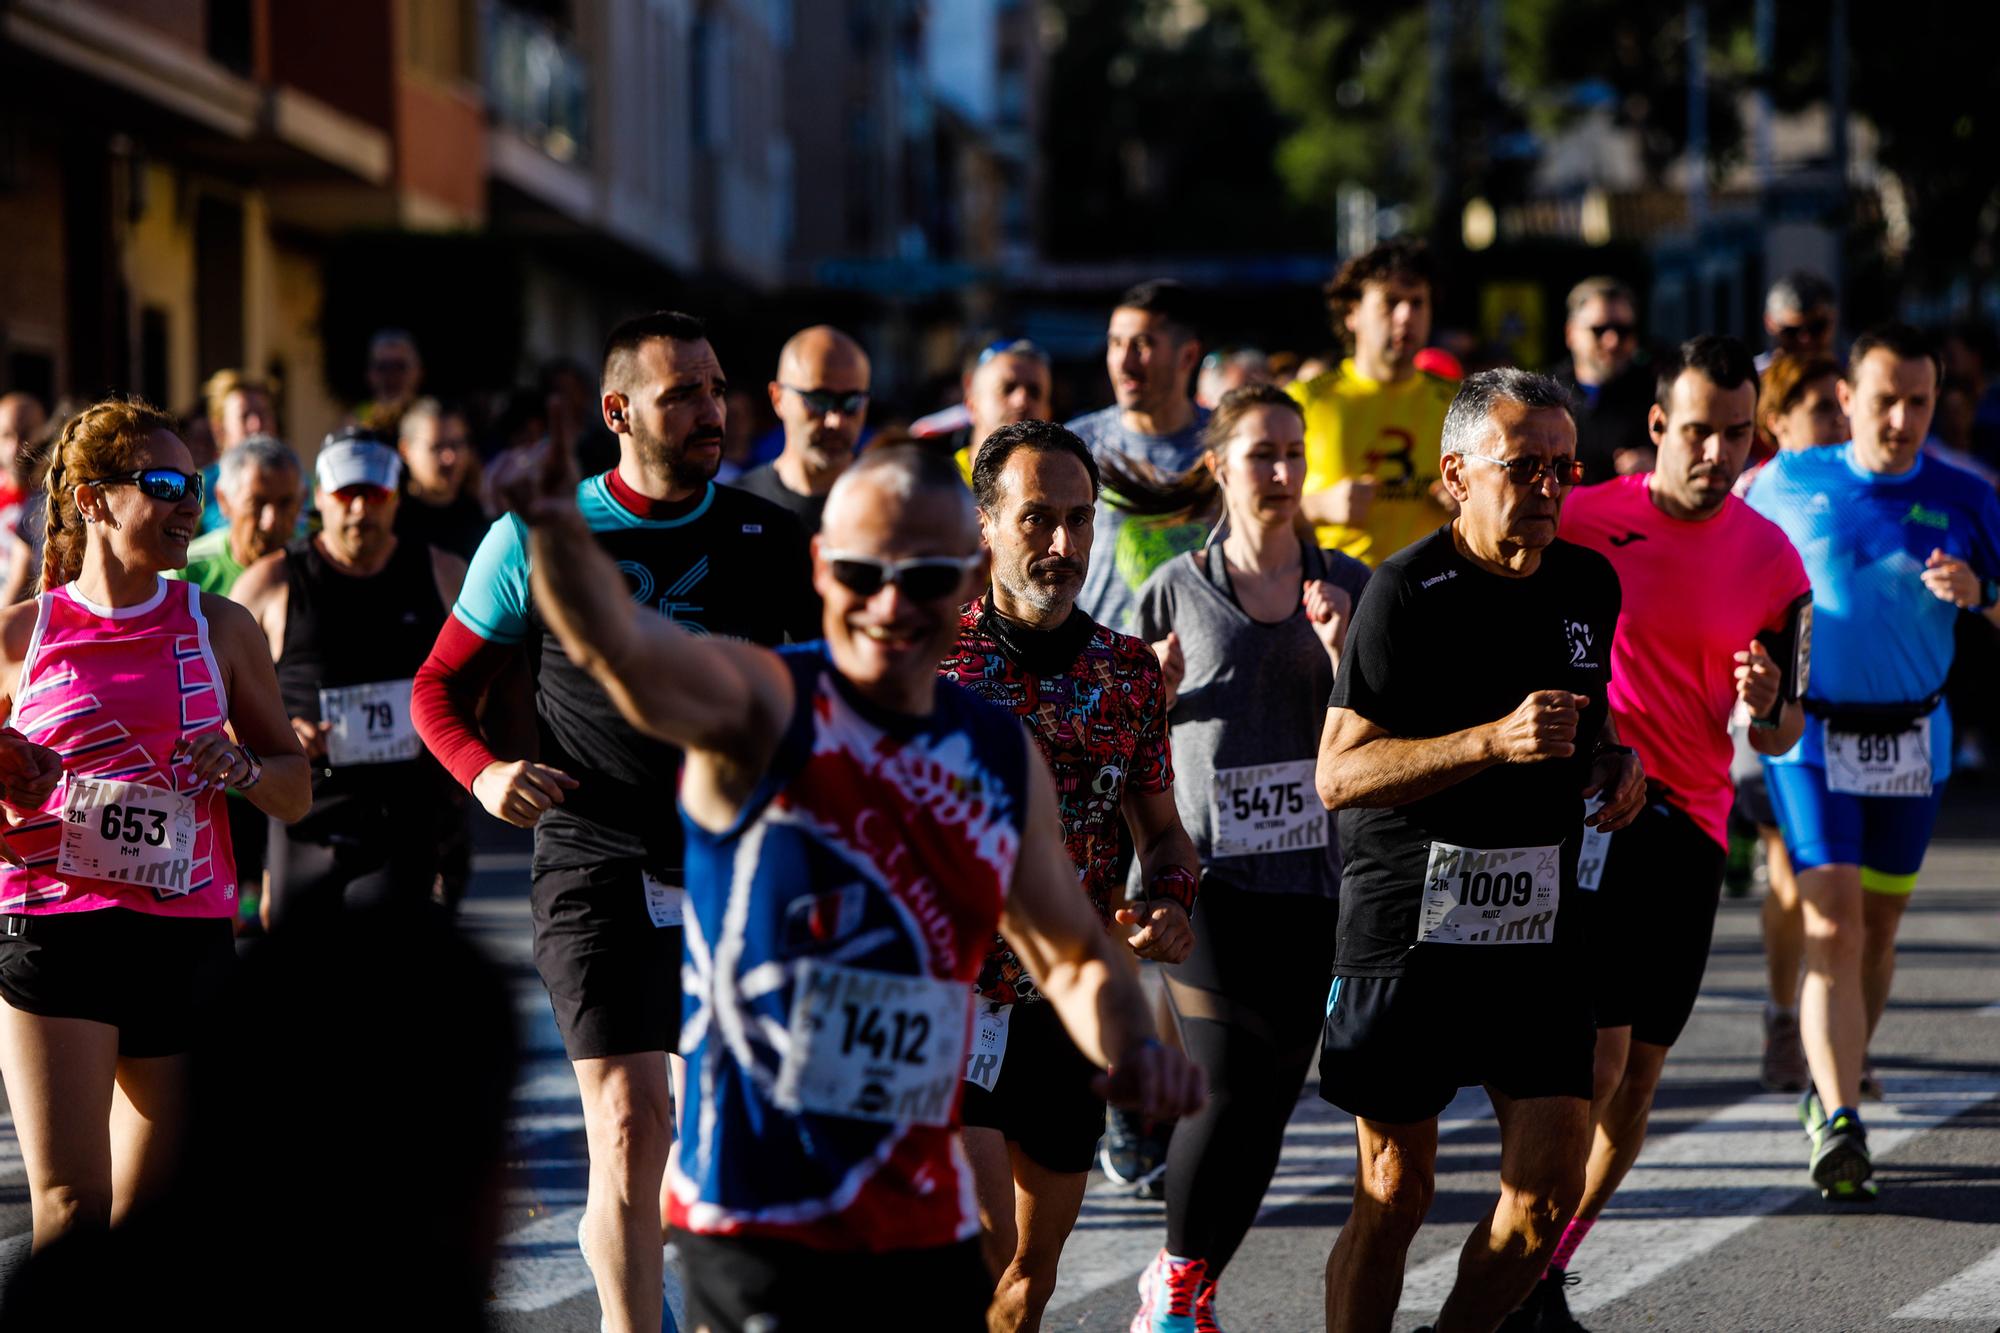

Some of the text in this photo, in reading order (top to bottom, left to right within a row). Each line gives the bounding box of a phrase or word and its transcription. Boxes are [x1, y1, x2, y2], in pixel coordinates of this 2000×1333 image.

[361, 701, 394, 730] 79
[1857, 731, 1899, 763] 991
[69, 810, 87, 823] 21k
[1232, 782, 1303, 821] 5475
[100, 803, 168, 847] 653
[120, 845, 140, 857] M+M
[1430, 879, 1450, 891] 21k
[1458, 871, 1533, 907] 1009
[1481, 909, 1501, 919] RUIZ
[840, 1002, 932, 1064] 1412
